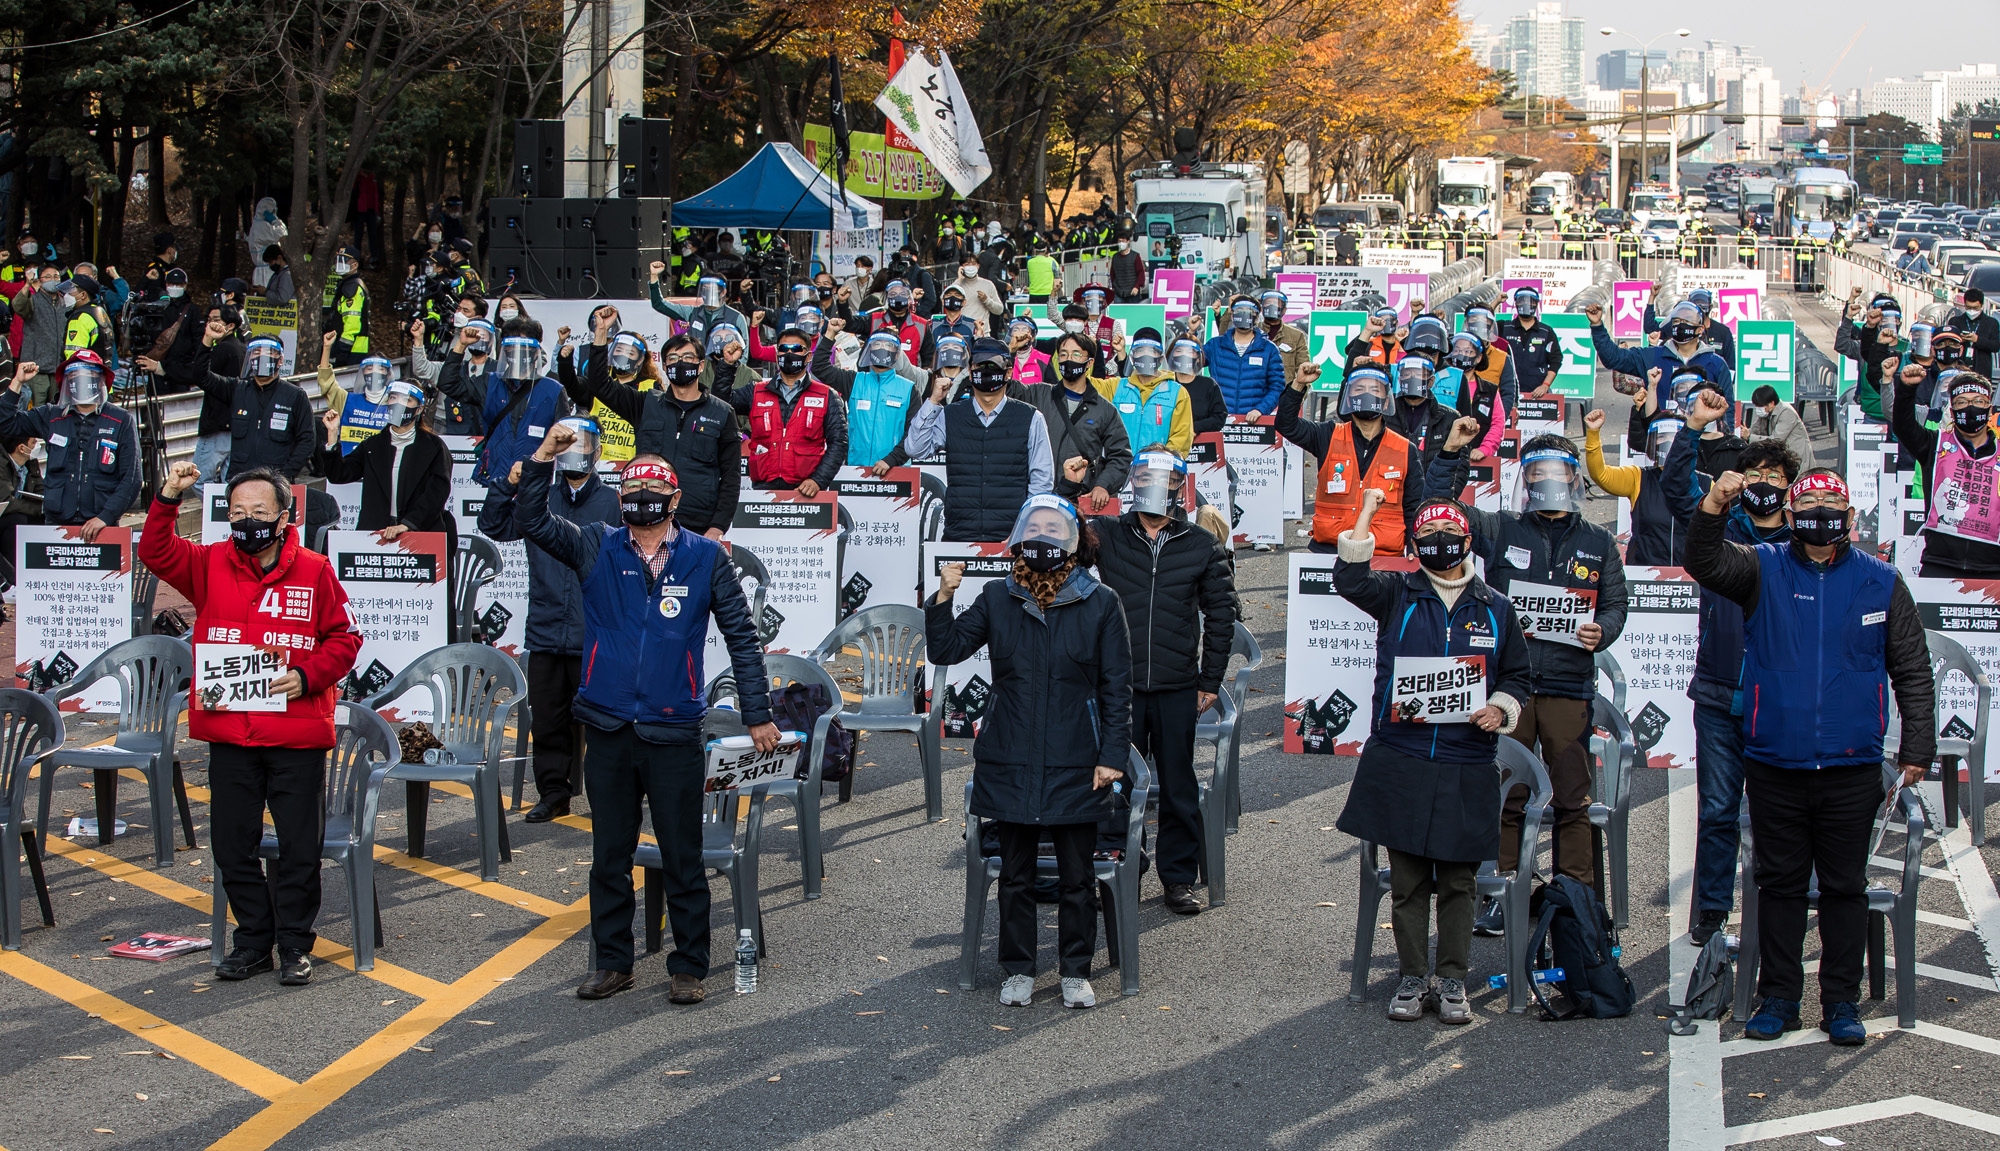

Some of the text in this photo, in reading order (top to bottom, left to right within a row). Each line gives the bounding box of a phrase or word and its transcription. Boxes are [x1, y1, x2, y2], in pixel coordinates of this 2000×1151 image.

[1156, 279, 1190, 312] 노
[1280, 282, 1314, 315] 동
[1390, 282, 1426, 322] 개
[1722, 294, 1757, 326] 지
[1740, 334, 1790, 381] 권
[651, 465, 672, 482] 투쟁
[1241, 468, 1279, 477] 없는 미디어,
[841, 484, 875, 493] 대학노동자
[1247, 479, 1268, 487] 세상을
[1793, 478, 1847, 496] 단결 투쟁
[1205, 491, 1221, 499] 도입!
[1555, 492, 1566, 501] 3법
[1744, 488, 1777, 506] 전태일 3법
[648, 503, 662, 512] 3법
[744, 505, 820, 514] 이스타항공조종사지부
[759, 517, 805, 526] 권경수조합원
[1447, 507, 1465, 528] 투쟁
[871, 522, 900, 533] 공공성
[1796, 519, 1842, 529] 전태일 3법
[256, 528, 270, 539] 3법
[865, 536, 905, 546] 강화하자!
[46, 545, 101, 556] 한국마사회지부
[801, 546, 824, 555] 먹튀한
[1047, 548, 1061, 557] 3법
[1447, 544, 1459, 554] 3법
[50, 557, 74, 566] 노동자
[354, 556, 418, 567] 마사회 경마기수
[775, 558, 823, 567] 이상직 처벌과
[967, 561, 1012, 571] 교사노동자
[345, 568, 430, 579] 고 문중원 열사 유가족
[791, 570, 831, 579] 철회를 위해
[25, 581, 49, 590] 자회사
[778, 582, 816, 591] 투쟁중이고
[1634, 584, 1692, 596] 청년비정규직
[57, 593, 89, 603] 반영하고
[287, 590, 309, 599] 이호동
[771, 595, 819, 603] 농성중입니다.
[258, 588, 282, 618] 4
[348, 598, 434, 610] 공공기관에서 더이상
[1512, 596, 1591, 614] 전태일3법
[1628, 597, 1700, 609] 고 김용균 유가족
[50, 605, 99, 615] 적용 금지하라
[26, 616, 123, 627] 전태일 3법 입법하여 원청이
[383, 614, 429, 626] 비정규직의
[1309, 619, 1376, 632] 법외노조 20년
[1536, 617, 1576, 633] 쟁취!
[1942, 618, 1998, 630] 노동자 서재유
[42, 628, 107, 638] 간접고용 노동자와
[207, 627, 241, 643] 새로운
[363, 630, 420, 641] 죽음이 없기를
[263, 632, 315, 651] 이호동과
[1308, 638, 1360, 650] 보험설계사
[1624, 633, 1668, 645] 더이상 내
[40, 640, 109, 650] 직접 교섭하게 하라!
[1631, 648, 1662, 660] 일하다
[204, 652, 280, 680] 노동개악
[1331, 657, 1376, 668] 보장하라!
[1640, 663, 1695, 675] 세상을 위해
[1397, 663, 1481, 695] 전태일3법
[1629, 678, 1661, 689] 오늘도
[230, 678, 273, 702] 저지!
[1428, 691, 1471, 714] 쟁취!
[716, 746, 795, 772] 노동개악
[740, 758, 784, 784] 저지!
